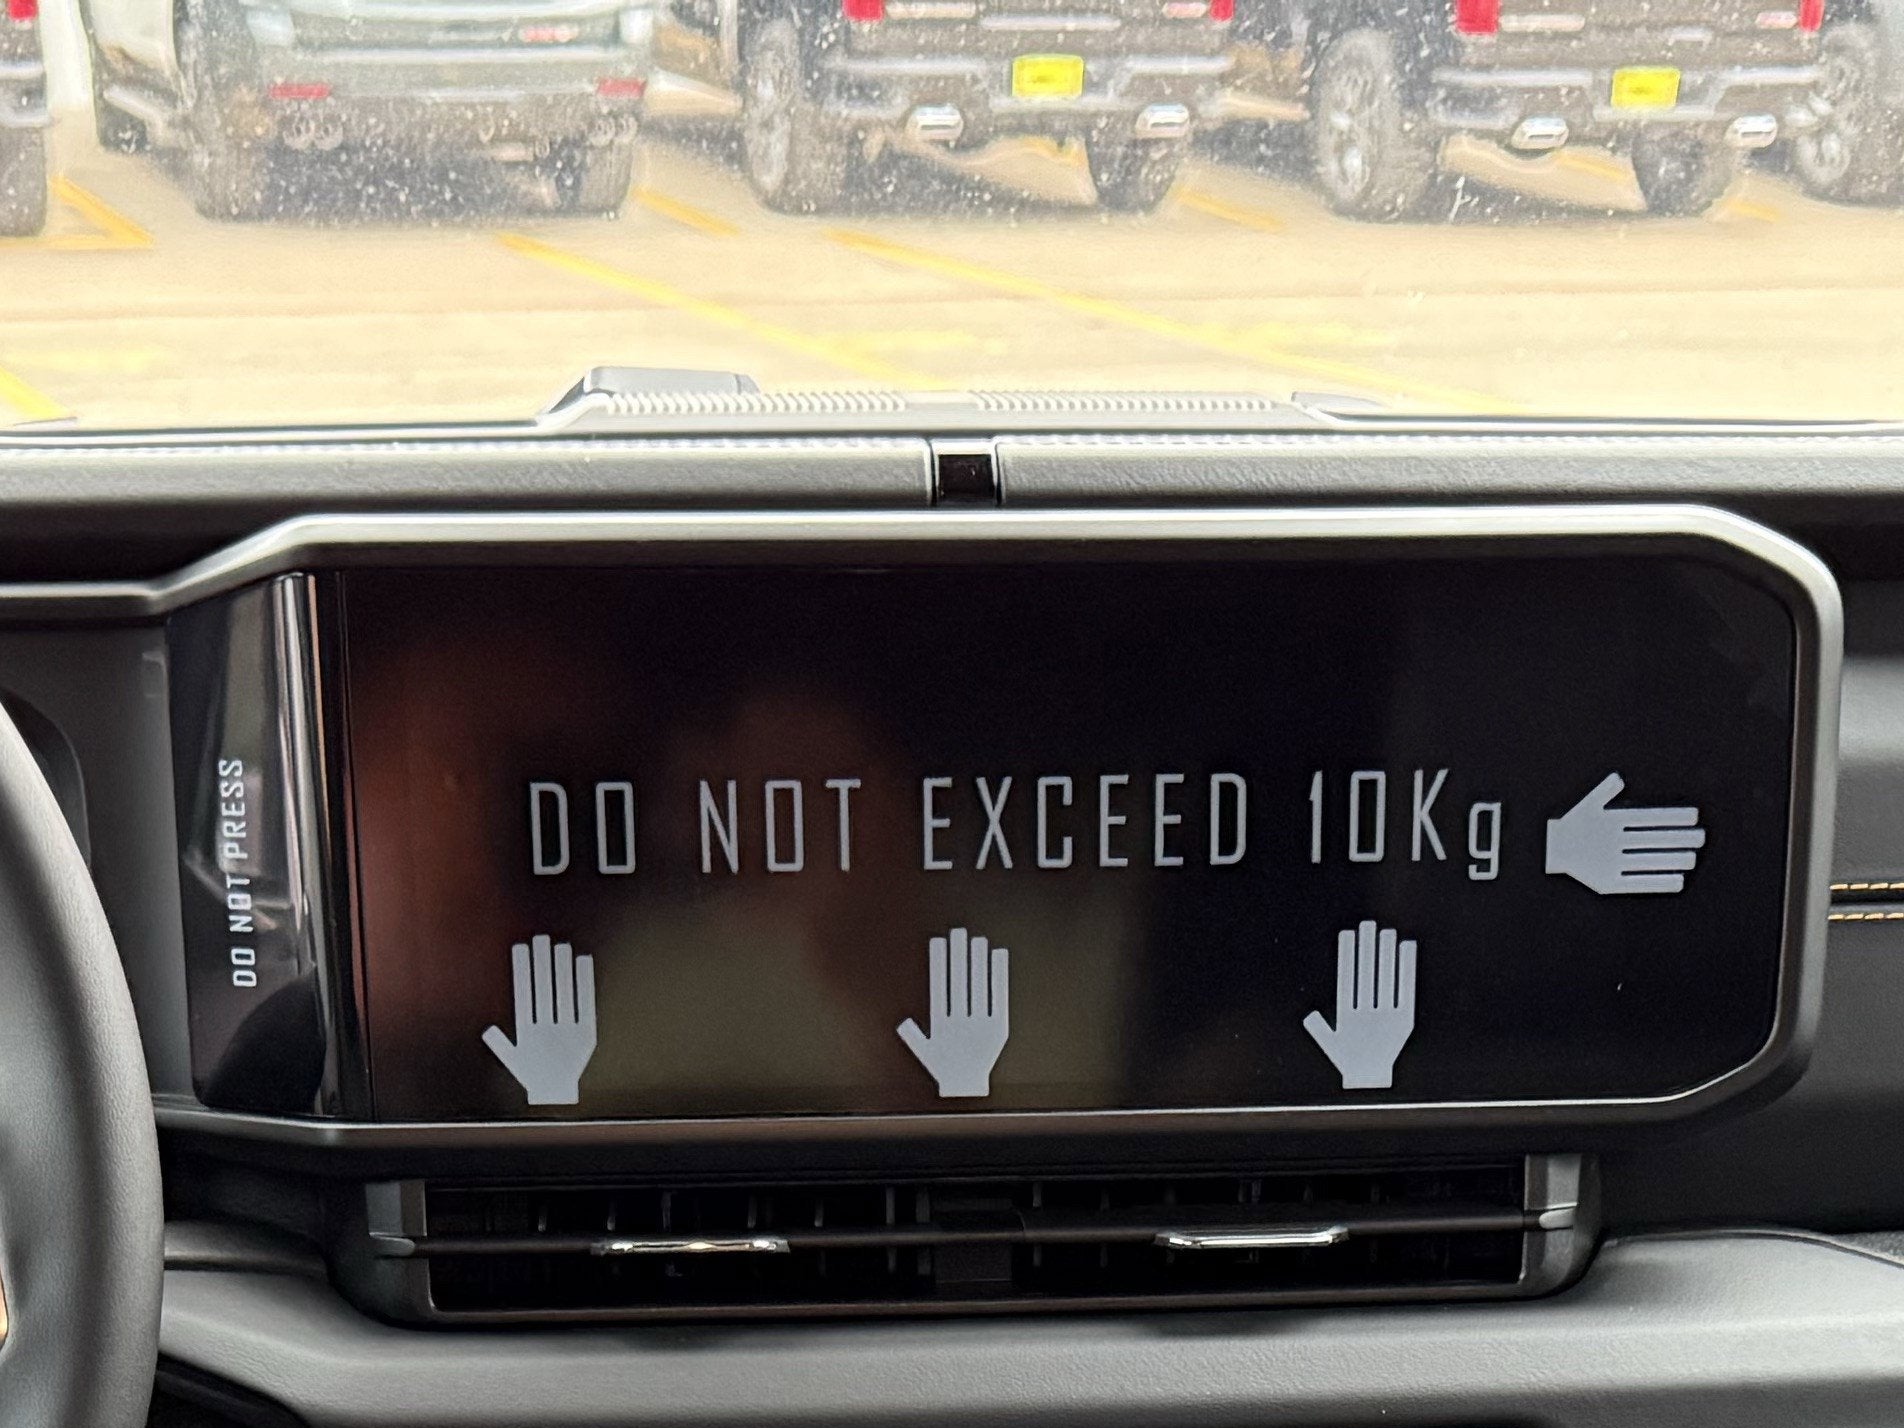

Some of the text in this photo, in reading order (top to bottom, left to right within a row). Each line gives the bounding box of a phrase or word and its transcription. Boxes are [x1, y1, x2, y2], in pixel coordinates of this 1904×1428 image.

[218, 758, 257, 988] DO NOT PRESS
[530, 768, 1503, 881] DO NOT EXCEED 10Kg
